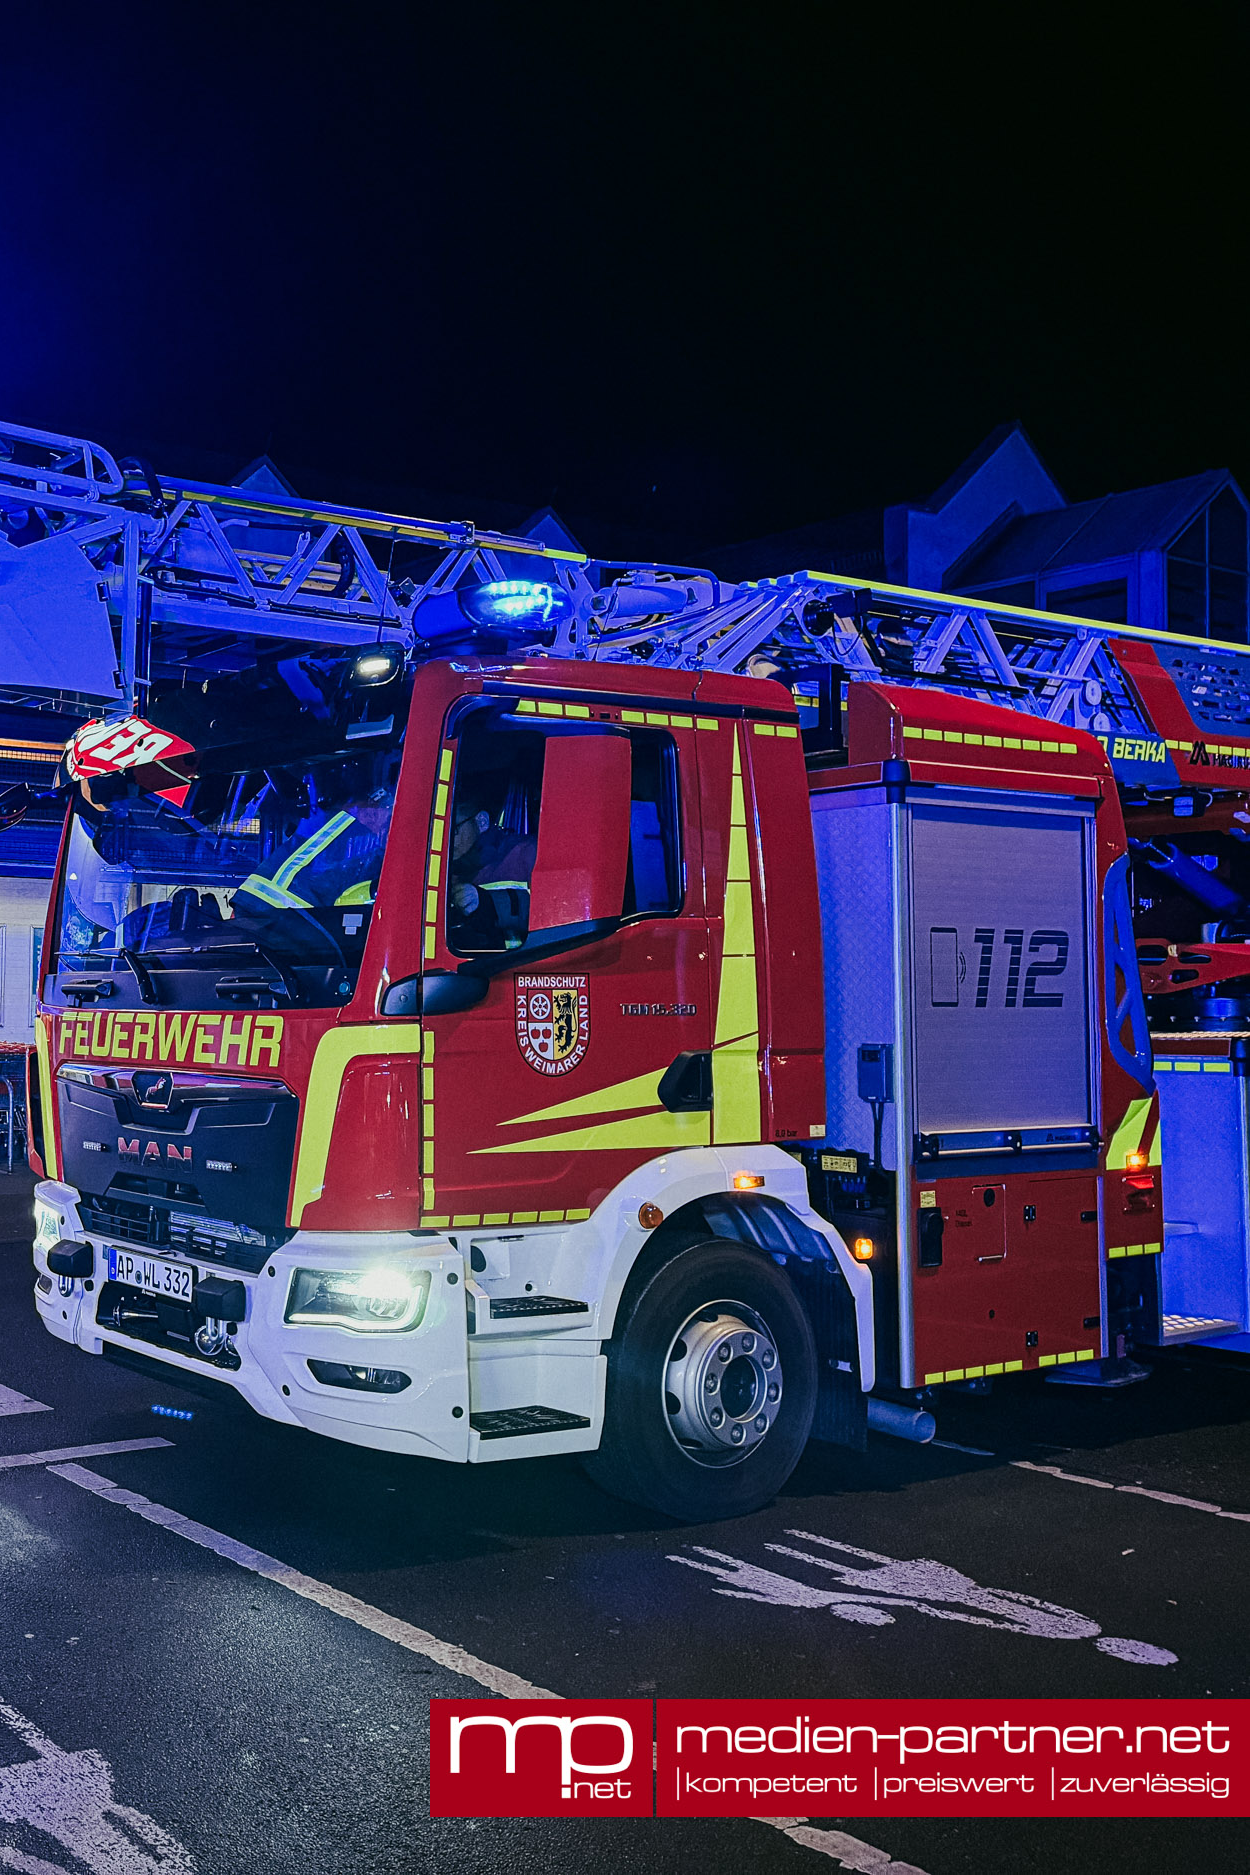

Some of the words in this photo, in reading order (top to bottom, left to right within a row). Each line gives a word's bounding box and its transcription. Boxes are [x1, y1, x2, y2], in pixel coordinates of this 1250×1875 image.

[1113, 737, 1166, 763] BERKA
[518, 976, 586, 988] BRANDSCHUTZ
[973, 927, 1070, 1008] 112
[620, 1003, 649, 1016] TGM
[651, 1003, 697, 1016] 15.320
[58, 1011, 284, 1068] FEUERWEHR
[517, 995, 529, 1047] KREIS
[524, 1044, 586, 1074] WEIMARER
[579, 995, 589, 1041] LAND
[787, 1129, 798, 1137] bar
[118, 1136, 193, 1174] MAN
[117, 1255, 134, 1281] AP
[143, 1261, 161, 1289] WL
[163, 1266, 190, 1298] 332
